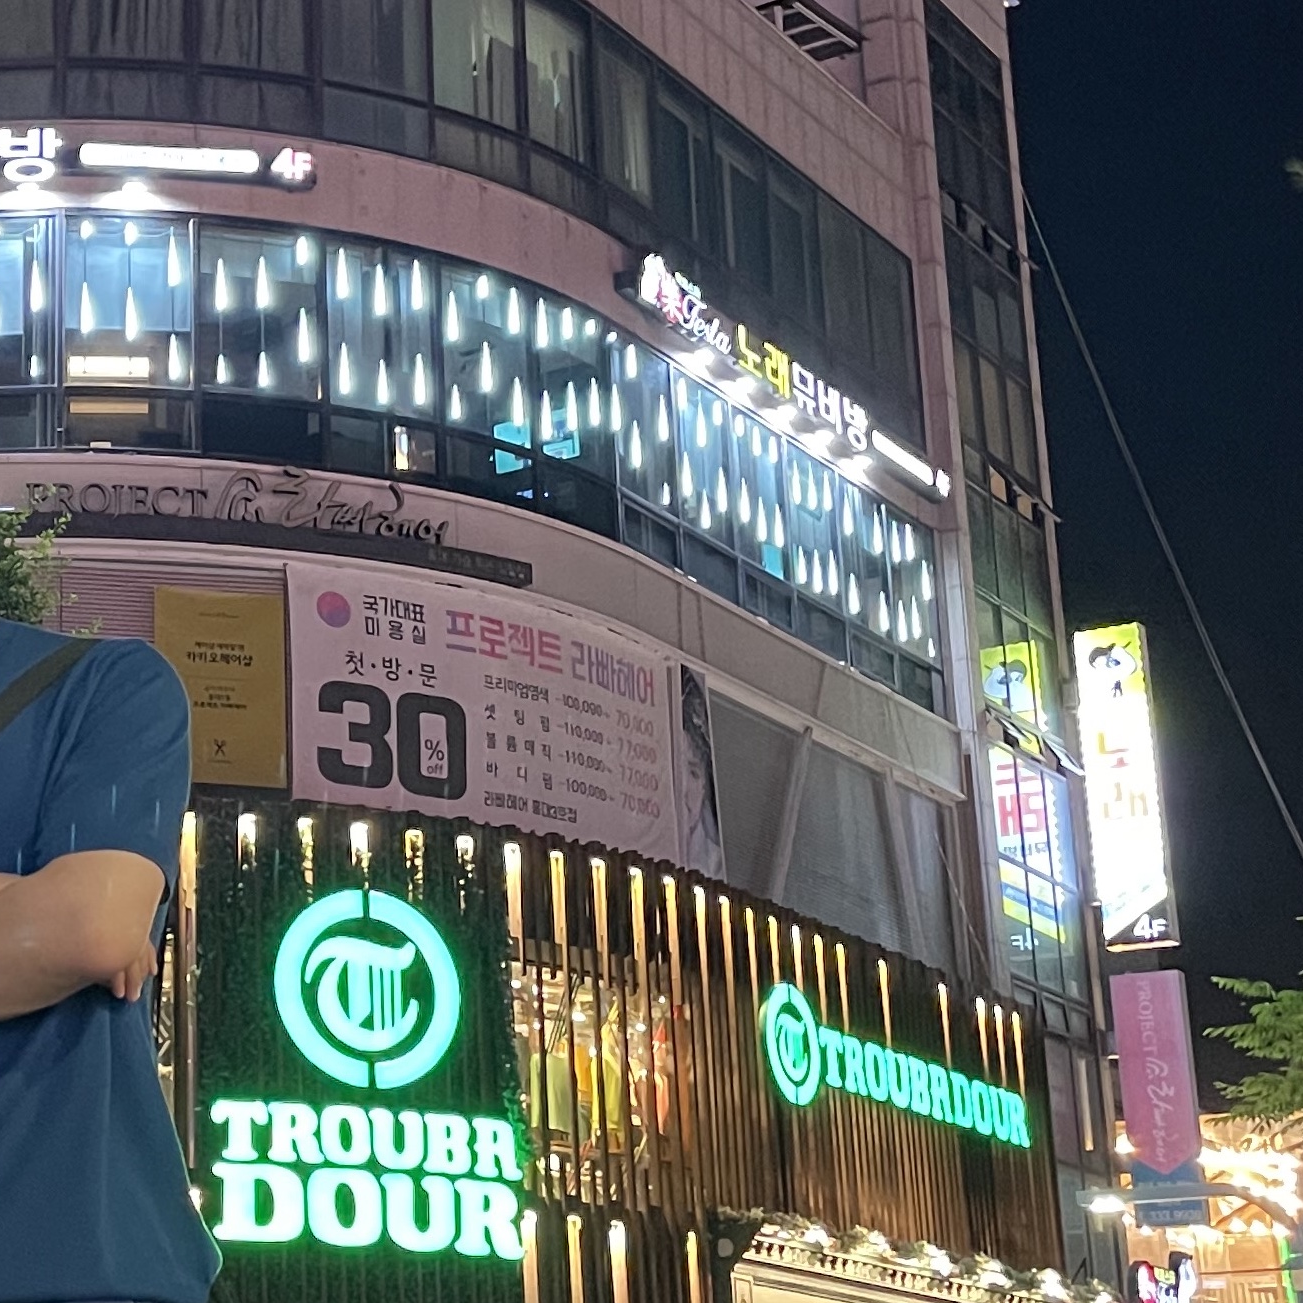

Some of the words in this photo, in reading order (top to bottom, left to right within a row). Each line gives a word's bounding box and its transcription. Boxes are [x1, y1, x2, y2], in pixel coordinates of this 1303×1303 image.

[270, 147, 313, 181] 4F
[26, 482, 208, 519] PROJECT
[363, 595, 426, 624] 국가대표
[446, 610, 564, 675] 프로젝트
[571, 640, 656, 708] 라빠헤어
[484, 674, 549, 703] 프리미엄염색
[317, 680, 467, 800] 30
[426, 764, 444, 775] off
[1133, 913, 1167, 939] 4F
[1137, 980, 1159, 1054] PROJECT
[819, 1025, 1031, 1149] TROUBADOUR
[211, 1098, 524, 1182] TROUBA
[211, 1161, 527, 1261] DOUR
